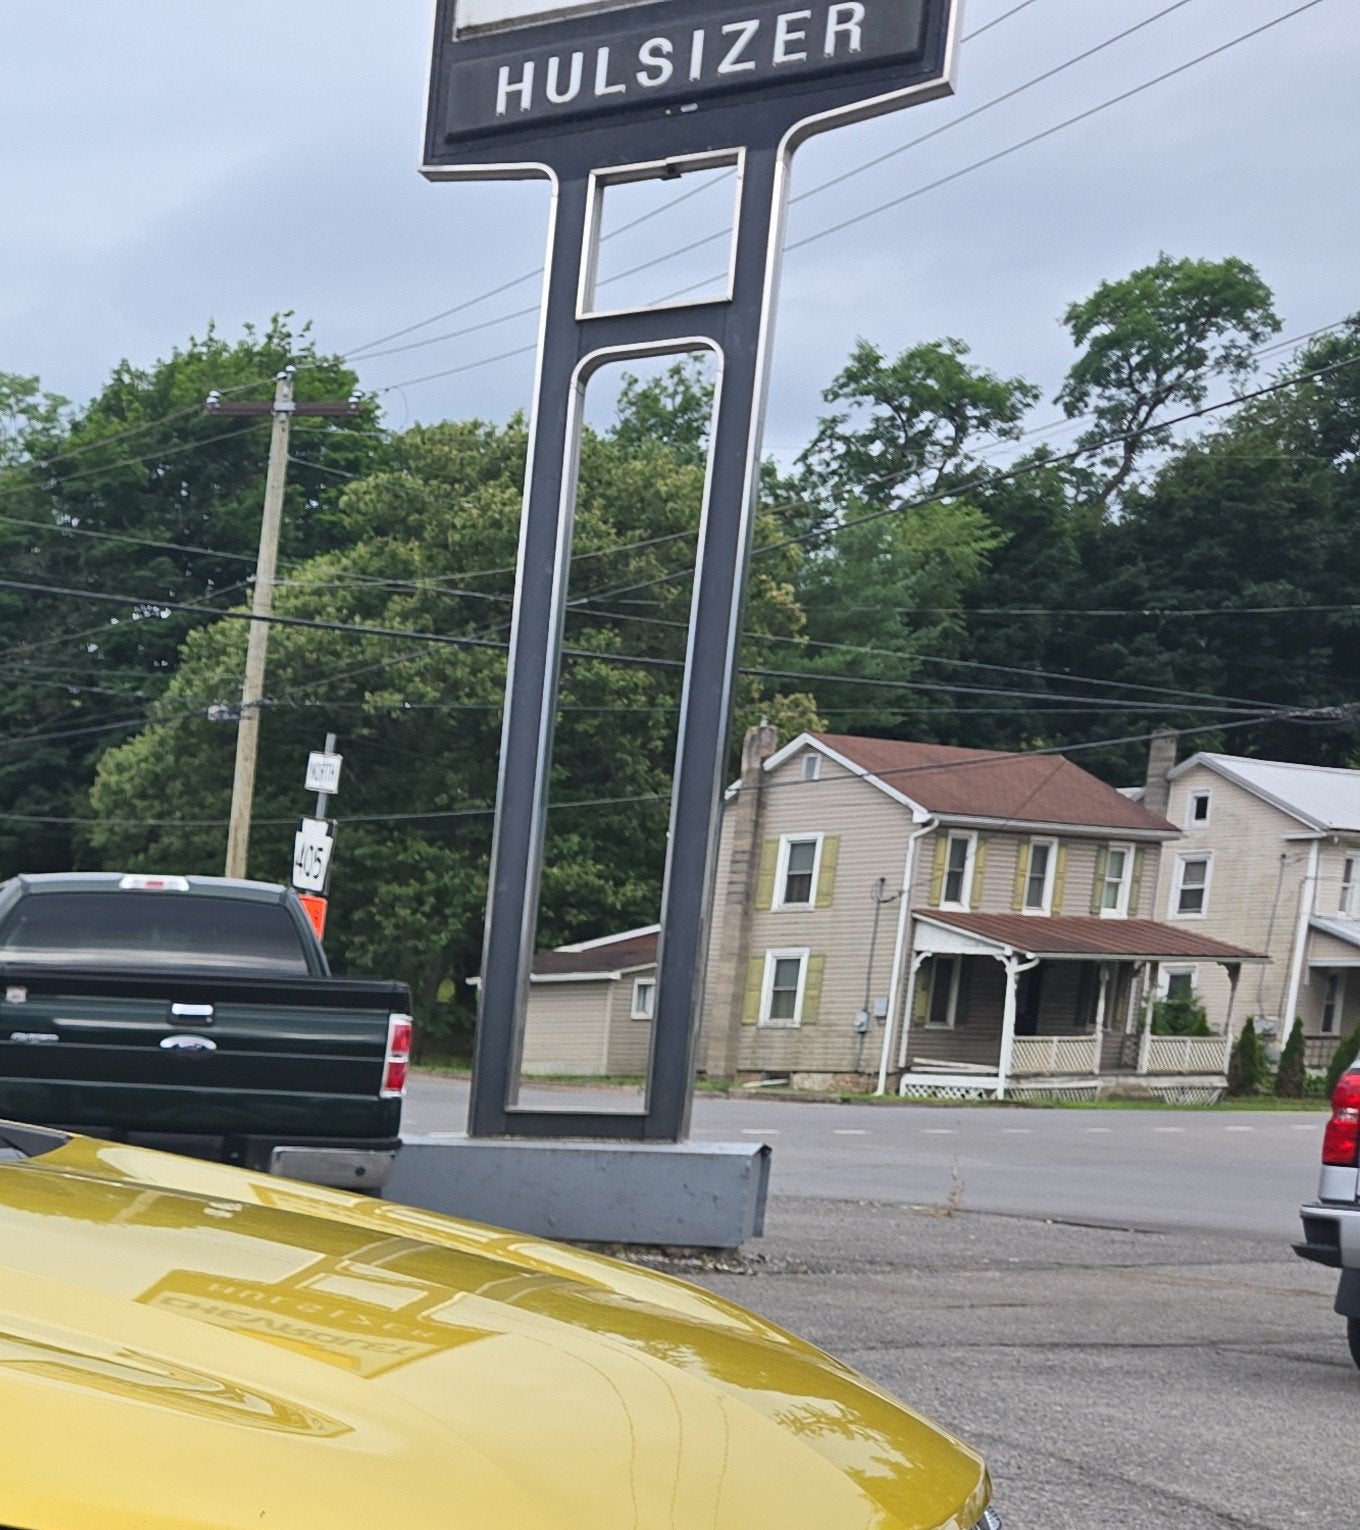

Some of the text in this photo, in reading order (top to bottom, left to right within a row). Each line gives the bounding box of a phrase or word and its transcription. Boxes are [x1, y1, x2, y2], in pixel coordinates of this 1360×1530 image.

[496, 1, 865, 116] HULSIZER
[310, 761, 336, 783] NORTH
[296, 840, 324, 879] 405
